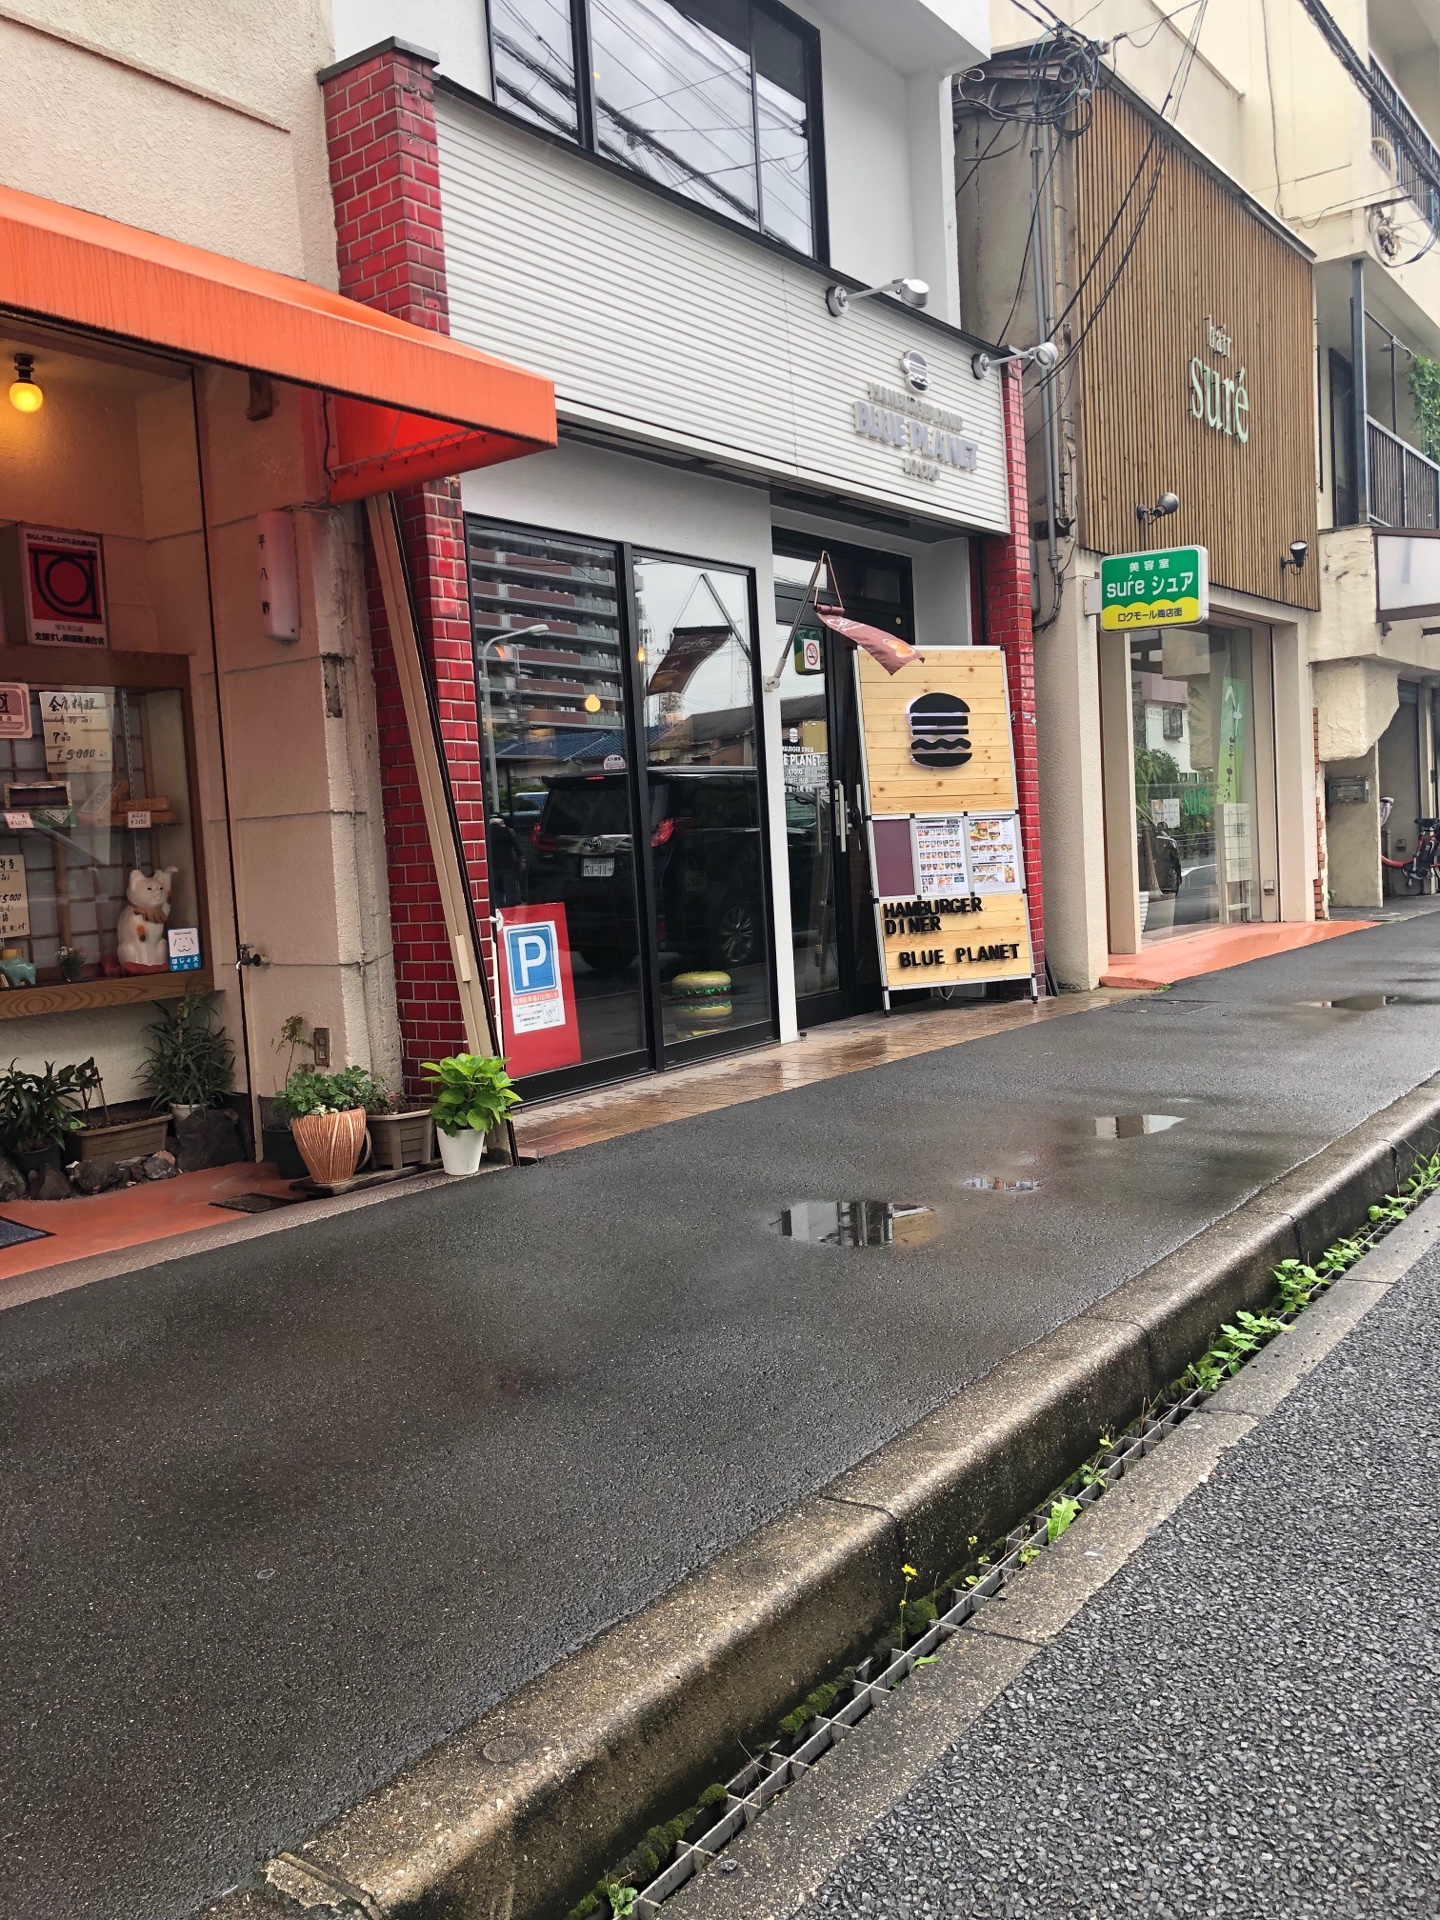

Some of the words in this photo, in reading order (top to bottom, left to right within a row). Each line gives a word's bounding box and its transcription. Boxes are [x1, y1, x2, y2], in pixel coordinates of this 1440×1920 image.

[1207, 313, 1231, 358] hair
[1190, 356, 1249, 444] suré
[853, 400, 906, 449] BLUE
[908, 421, 978, 472] PLANET
[1129, 558, 1170, 573] 美容室
[1151, 571, 1194, 596] シュア
[1117, 607, 1183, 623] ロクモール商店街
[790, 753, 821, 767] PLANET
[882, 896, 984, 919] HAMBURGER
[884, 915, 942, 936] DINER
[171, 955, 199, 965] ほじょ犬
[898, 949, 946, 969] BLUE
[955, 943, 1020, 963] PLANET
